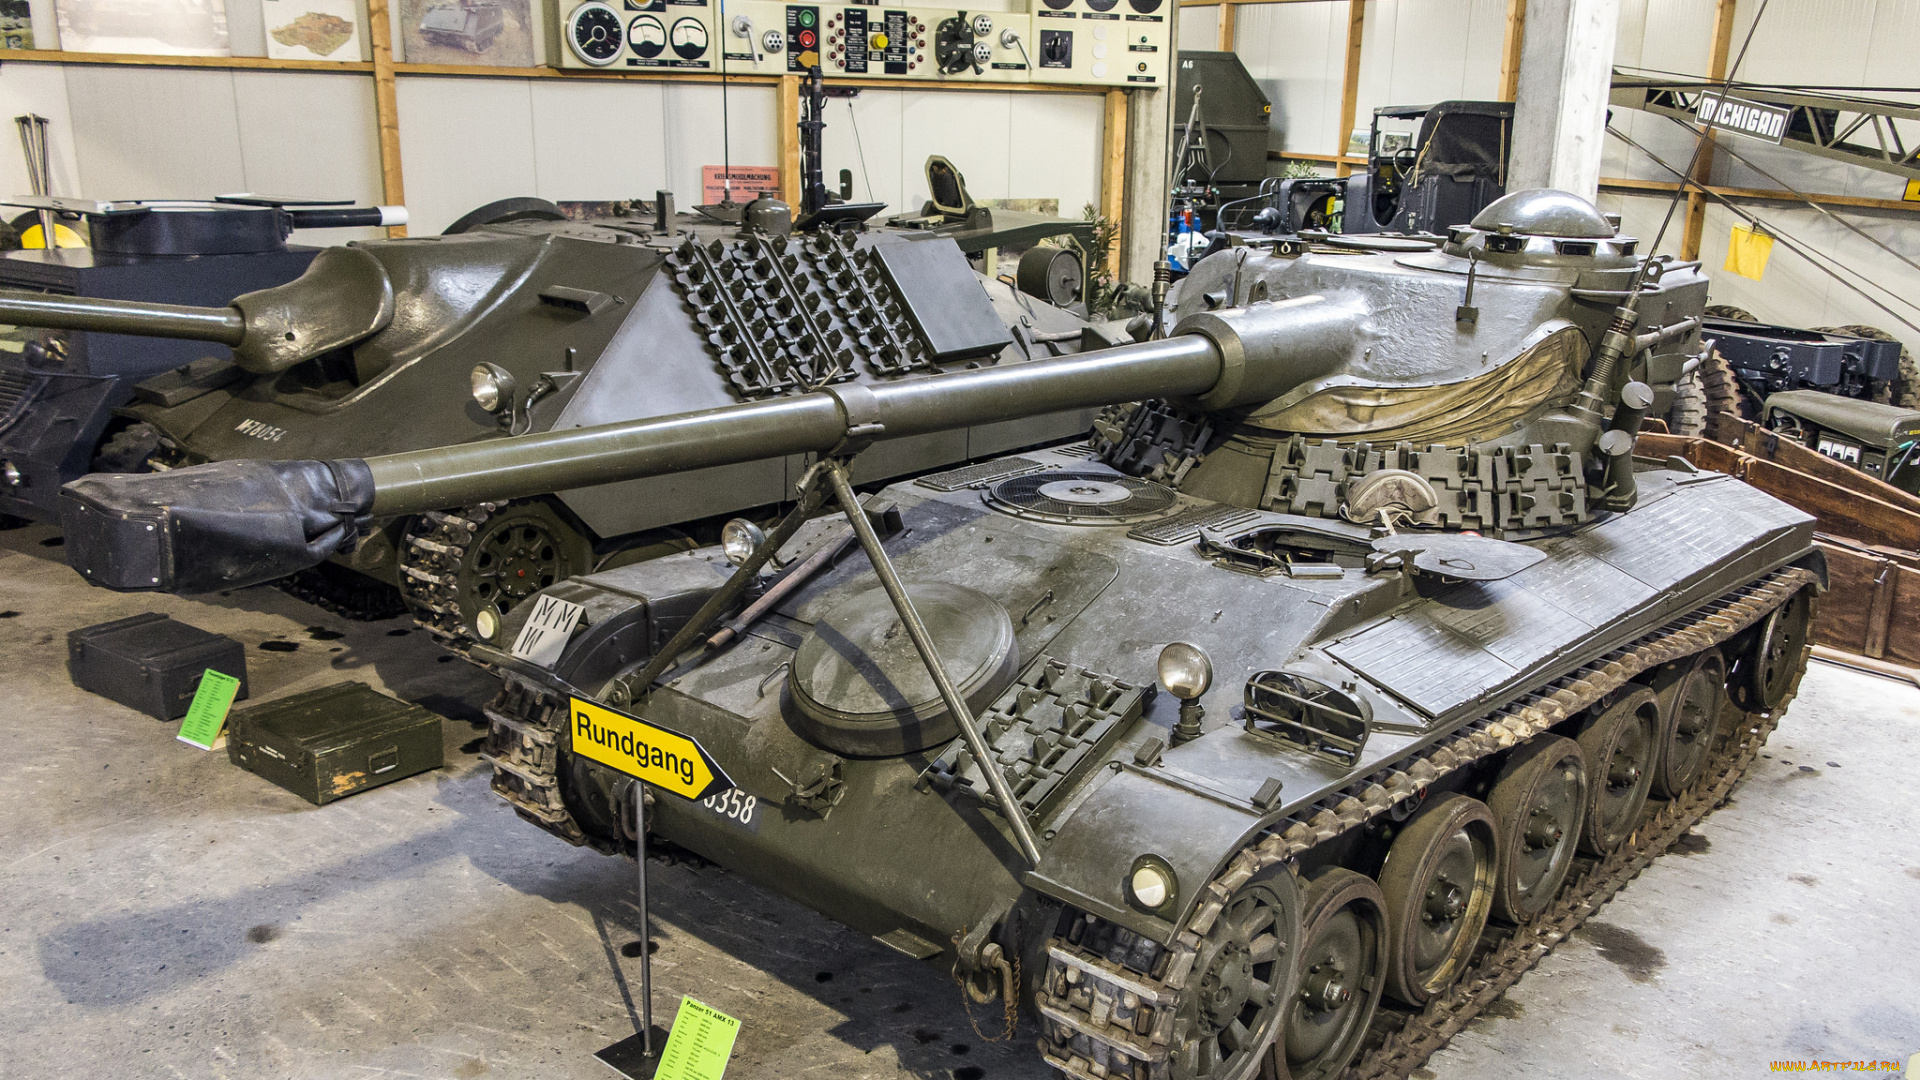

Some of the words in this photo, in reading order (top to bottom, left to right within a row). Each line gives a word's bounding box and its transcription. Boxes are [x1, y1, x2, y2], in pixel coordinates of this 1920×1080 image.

[1181, 60, 1194, 69] A6
[1699, 97, 1784, 137] MICHIGAN
[576, 711, 694, 786] Rundgang
[686, 1000, 704, 1012] Panzer
[713, 1013, 726, 1023] AMX
[728, 1019, 734, 1027] 13
